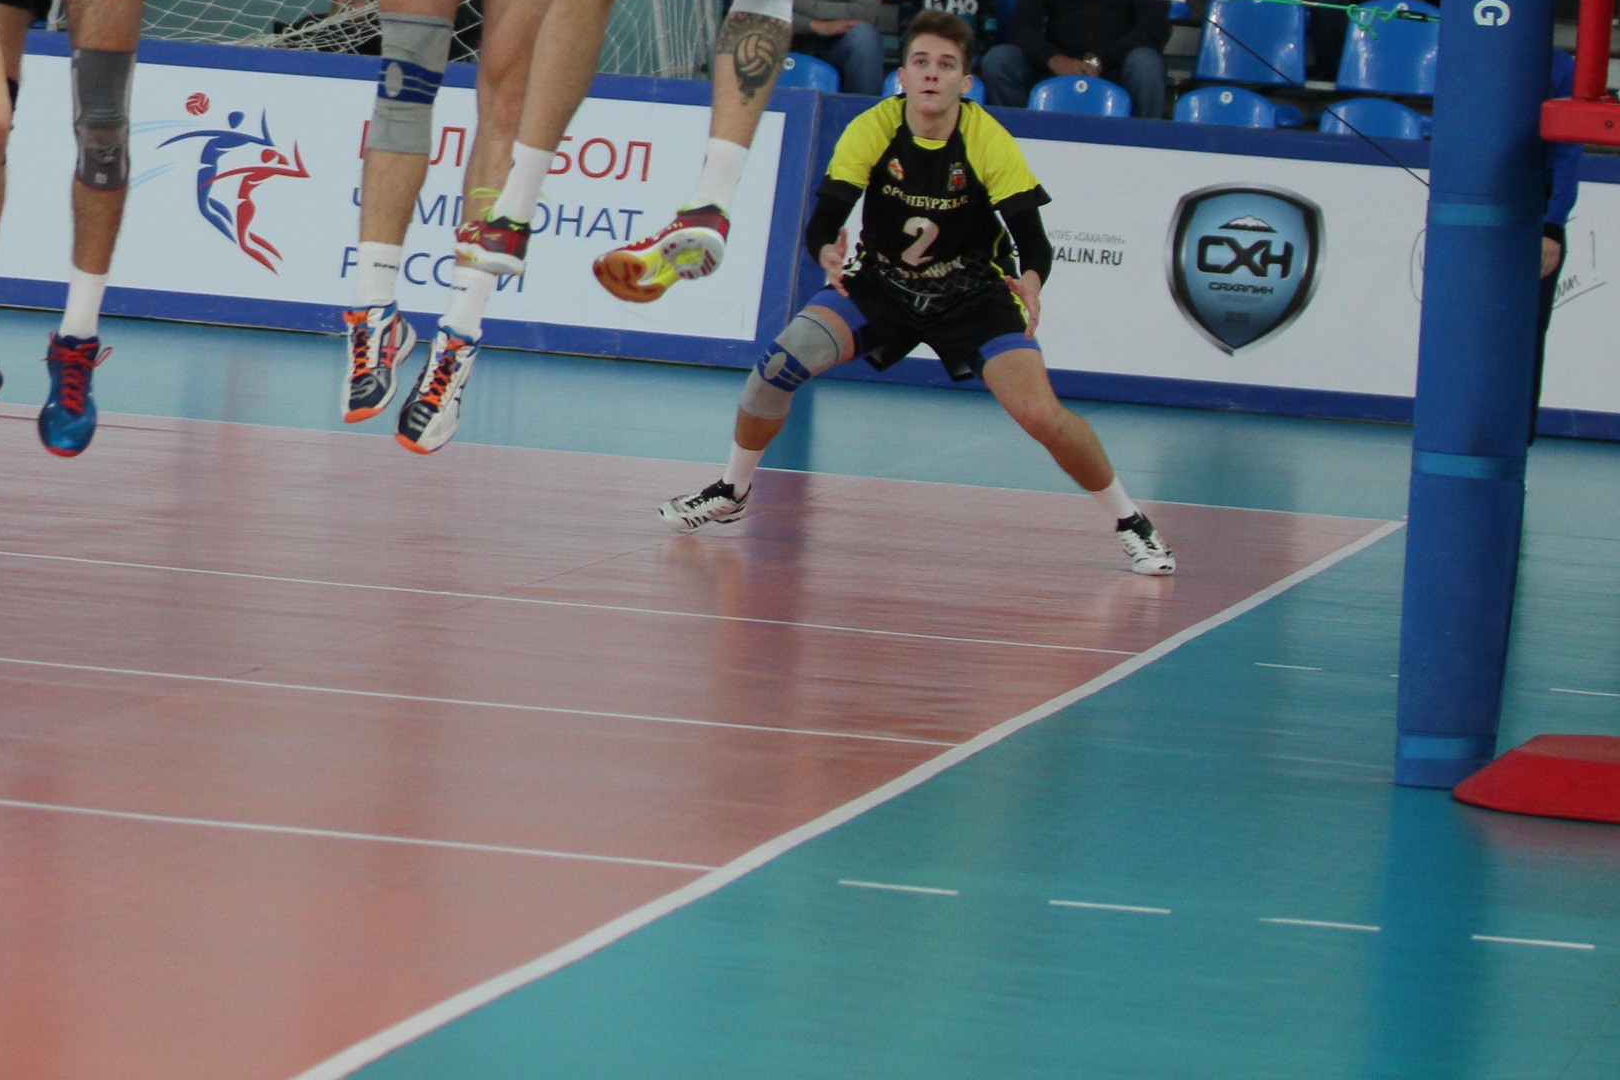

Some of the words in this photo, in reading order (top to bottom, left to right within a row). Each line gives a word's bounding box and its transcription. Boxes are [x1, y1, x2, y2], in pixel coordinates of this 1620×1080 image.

[359, 120, 653, 182] ЛБОЛ
[901, 216, 940, 267] 2
[1197, 235, 1294, 279] СХН
[341, 247, 526, 293] РССИ
[1208, 281, 1274, 295] САХАЛИН
